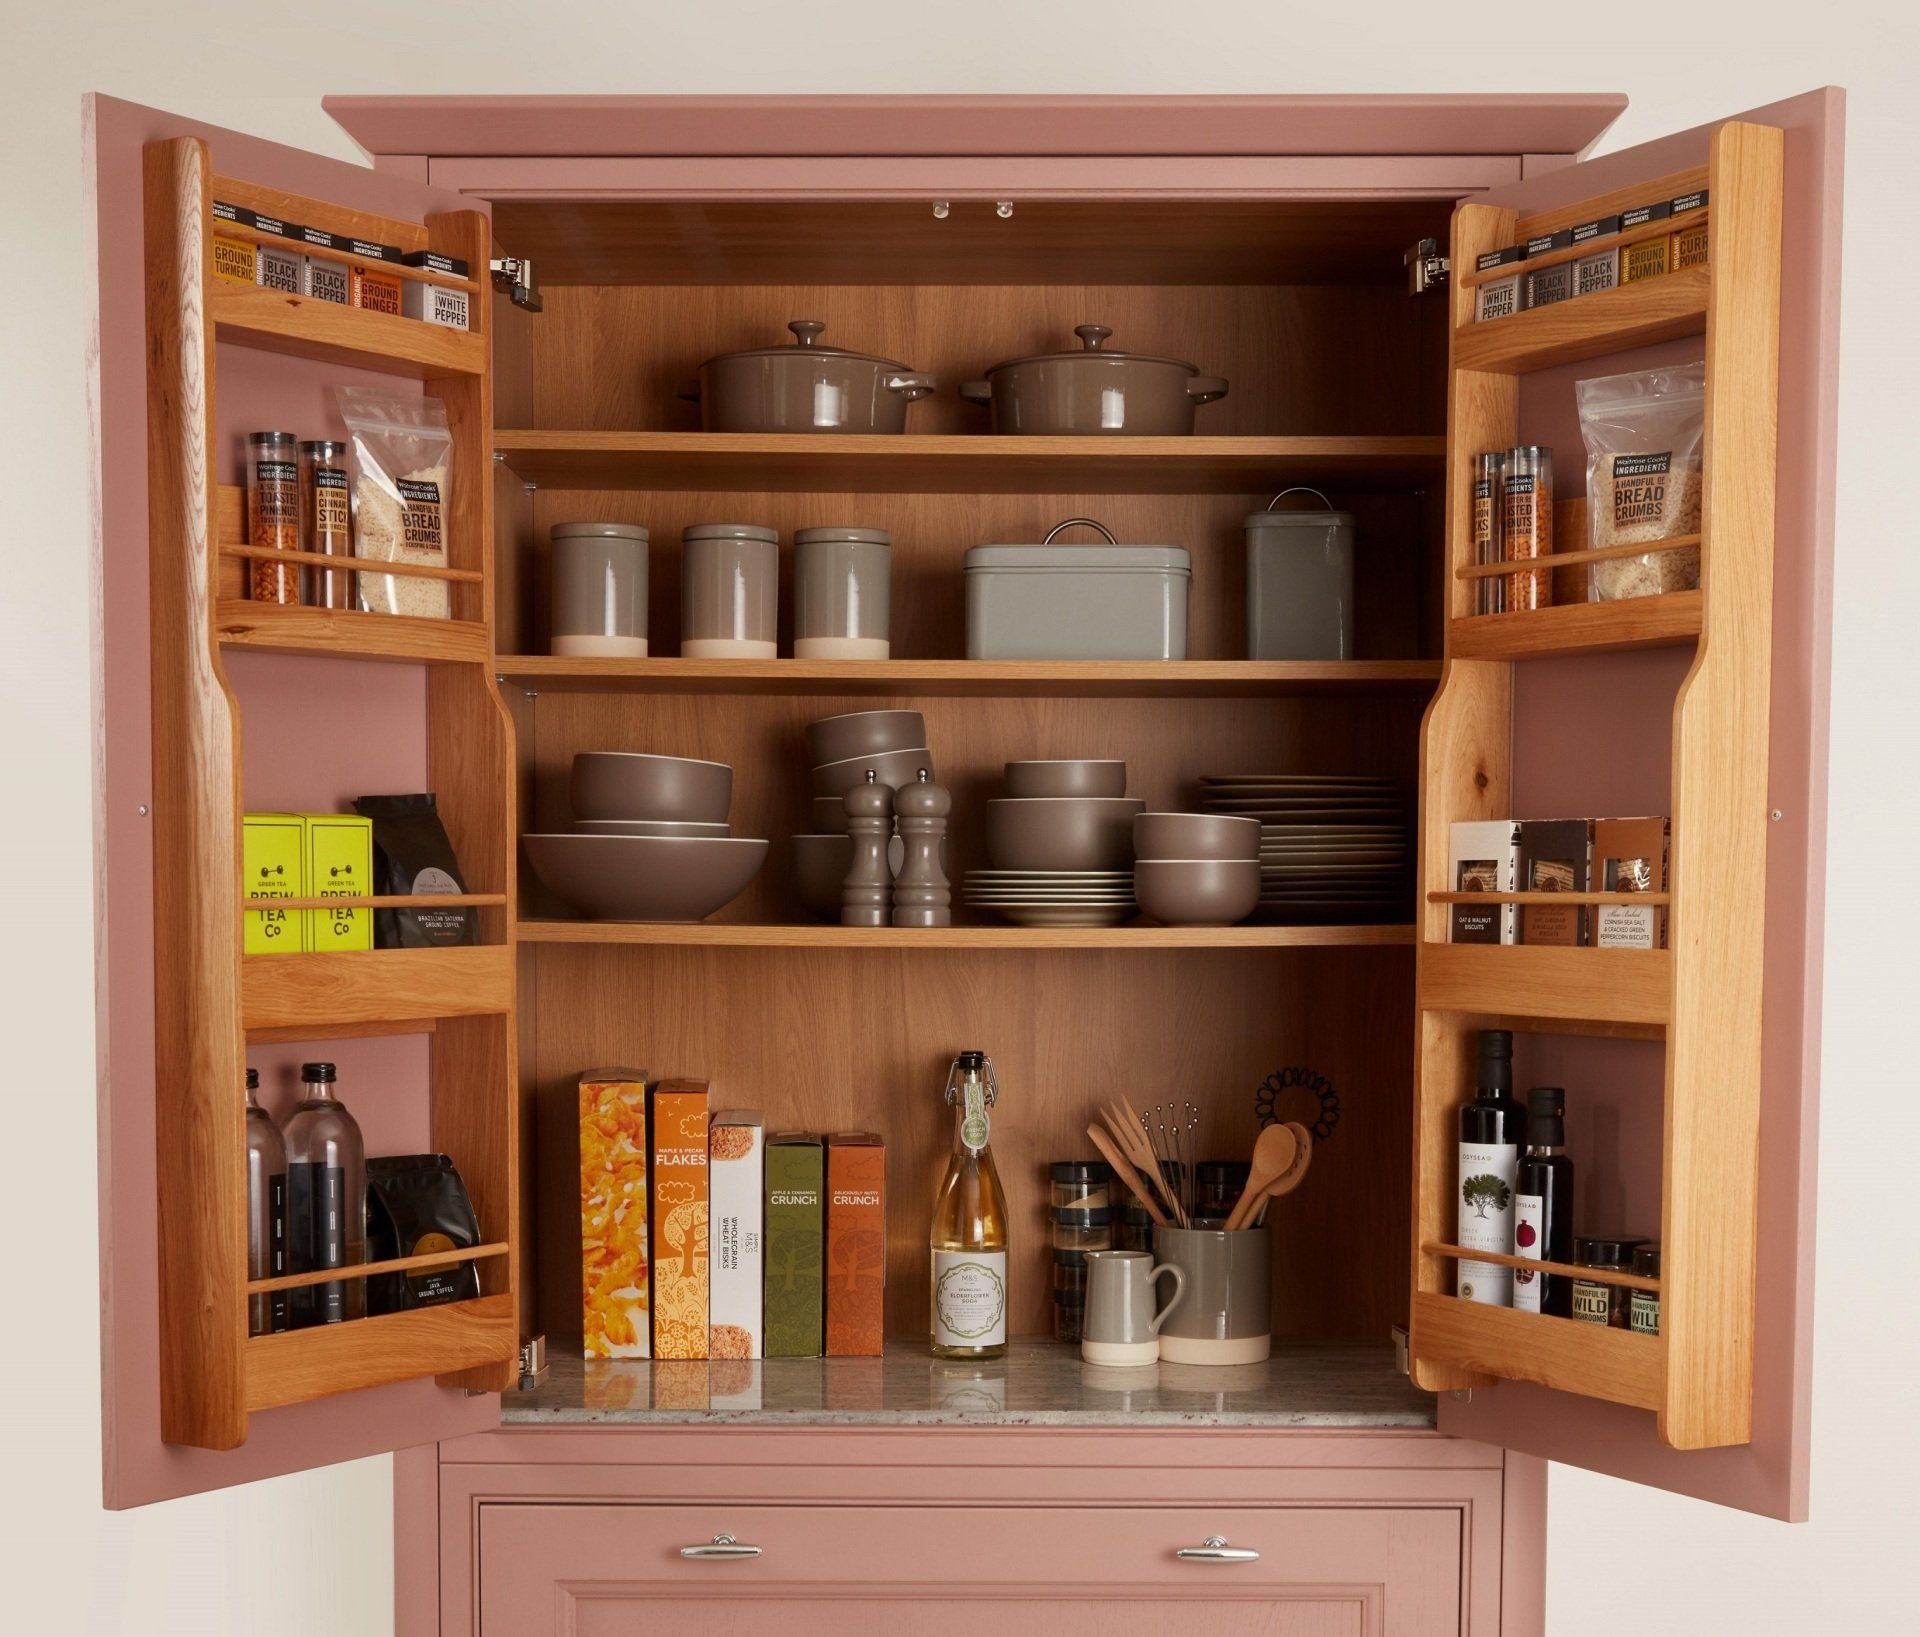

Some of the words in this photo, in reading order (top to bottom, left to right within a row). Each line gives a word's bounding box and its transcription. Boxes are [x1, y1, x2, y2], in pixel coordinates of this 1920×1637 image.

[1680, 236, 1708, 254] CURR
[215, 246, 252, 268] GROUND
[1630, 248, 1664, 266] GROUND
[215, 260, 253, 281] TURMERIC
[267, 260, 297, 281] BLACK
[1583, 260, 1612, 280] BLACK
[1630, 260, 1664, 281] CUMIN
[264, 274, 298, 294] PEPPER
[304, 264, 312, 296] ORGANIC
[316, 272, 346, 292] BLACK
[1538, 274, 1563, 292] BLACK
[1580, 274, 1612, 294] PEPPER
[312, 285, 346, 305] PEPPER
[361, 283, 398, 302] GROUND
[1486, 288, 1513, 306] WHITE
[1538, 288, 1566, 304] PEPPER
[362, 296, 398, 315] GINGER
[438, 296, 466, 314] WHITE
[1482, 302, 1512, 320] PEPPER
[435, 308, 466, 326] PEPPER
[1616, 456, 1646, 465] Waitrose
[1616, 462, 1666, 476] INGREDIENTS
[1616, 481, 1620, 490] A
[1621, 477, 1655, 488] HANDFUL
[400, 490, 438, 500] INGREDIENTS
[1616, 486, 1664, 506] BREAD
[408, 504, 433, 514] HANDFUL
[1616, 502, 1663, 521] CRUMBS
[402, 514, 440, 530] BREAD
[404, 528, 440, 544] CRUMBS
[259, 909, 286, 922] TEA
[329, 908, 354, 920] TEA
[265, 924, 281, 938] Co
[334, 922, 350, 936] Co
[656, 1154, 706, 1166] FLAKES
[771, 1196, 816, 1204] CRUNCH
[834, 1196, 879, 1205] CRUNCH
[744, 1232, 754, 1254] M&S
[418, 1290, 435, 1298] GROUND
[436, 1286, 454, 1294] COFFEE
[430, 1282, 440, 1290] JAVA
[1574, 1296, 1606, 1314] WILD
